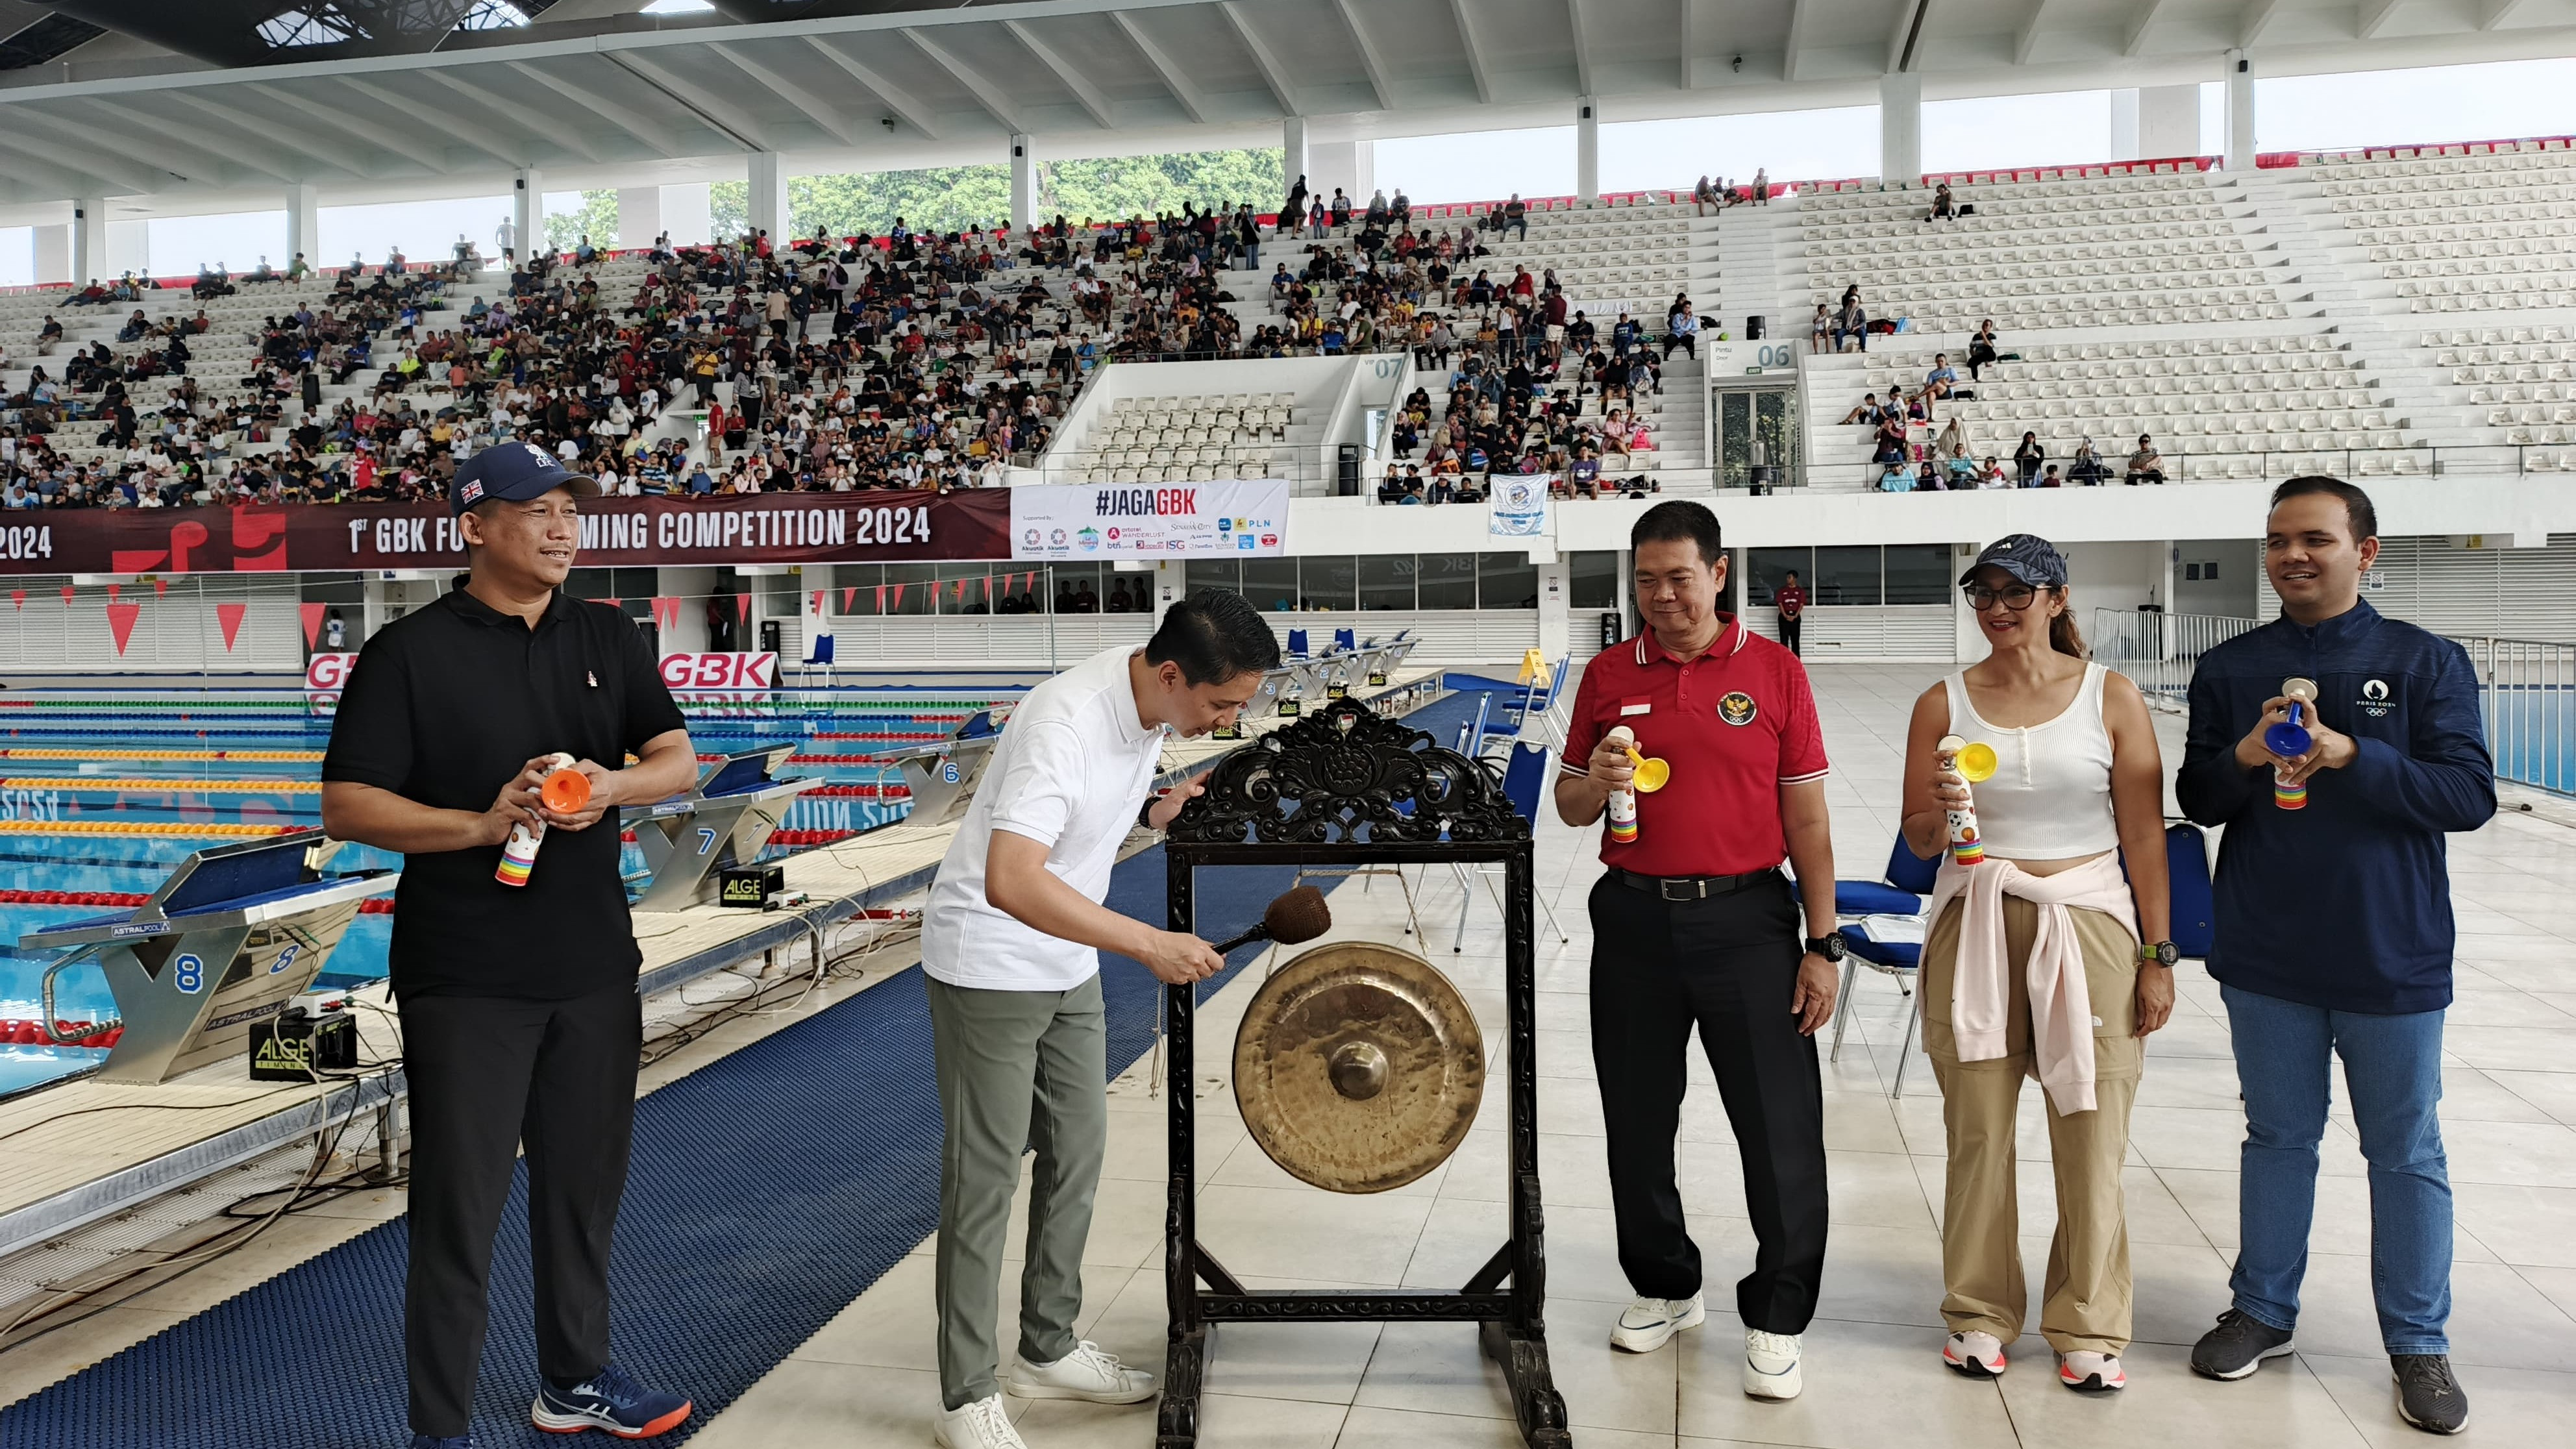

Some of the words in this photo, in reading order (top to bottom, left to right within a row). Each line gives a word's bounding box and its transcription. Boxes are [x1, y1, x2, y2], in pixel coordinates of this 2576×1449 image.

[1758, 345, 1789, 366] 06
[1376, 358, 1402, 378] 07
[1096, 488, 1196, 516] #JAGAGBK
[376, 518, 427, 552] GBK
[436, 517, 465, 552] FU
[577, 513, 647, 549] MING
[658, 509, 845, 549] COMPETITION
[857, 506, 930, 544] 2024
[1166, 540, 1185, 550] ISG
[658, 653, 774, 687] GBK
[1319, 667, 1330, 679] 2
[1265, 682, 1276, 695] 3
[943, 762, 960, 784] 6
[697, 828, 717, 855] 7
[724, 879, 760, 895] ALGE
[114, 924, 161, 935] ASTRALPOOL
[175, 953, 203, 995] 8
[269, 944, 301, 975] 8
[256, 1038, 310, 1061] ALGE
